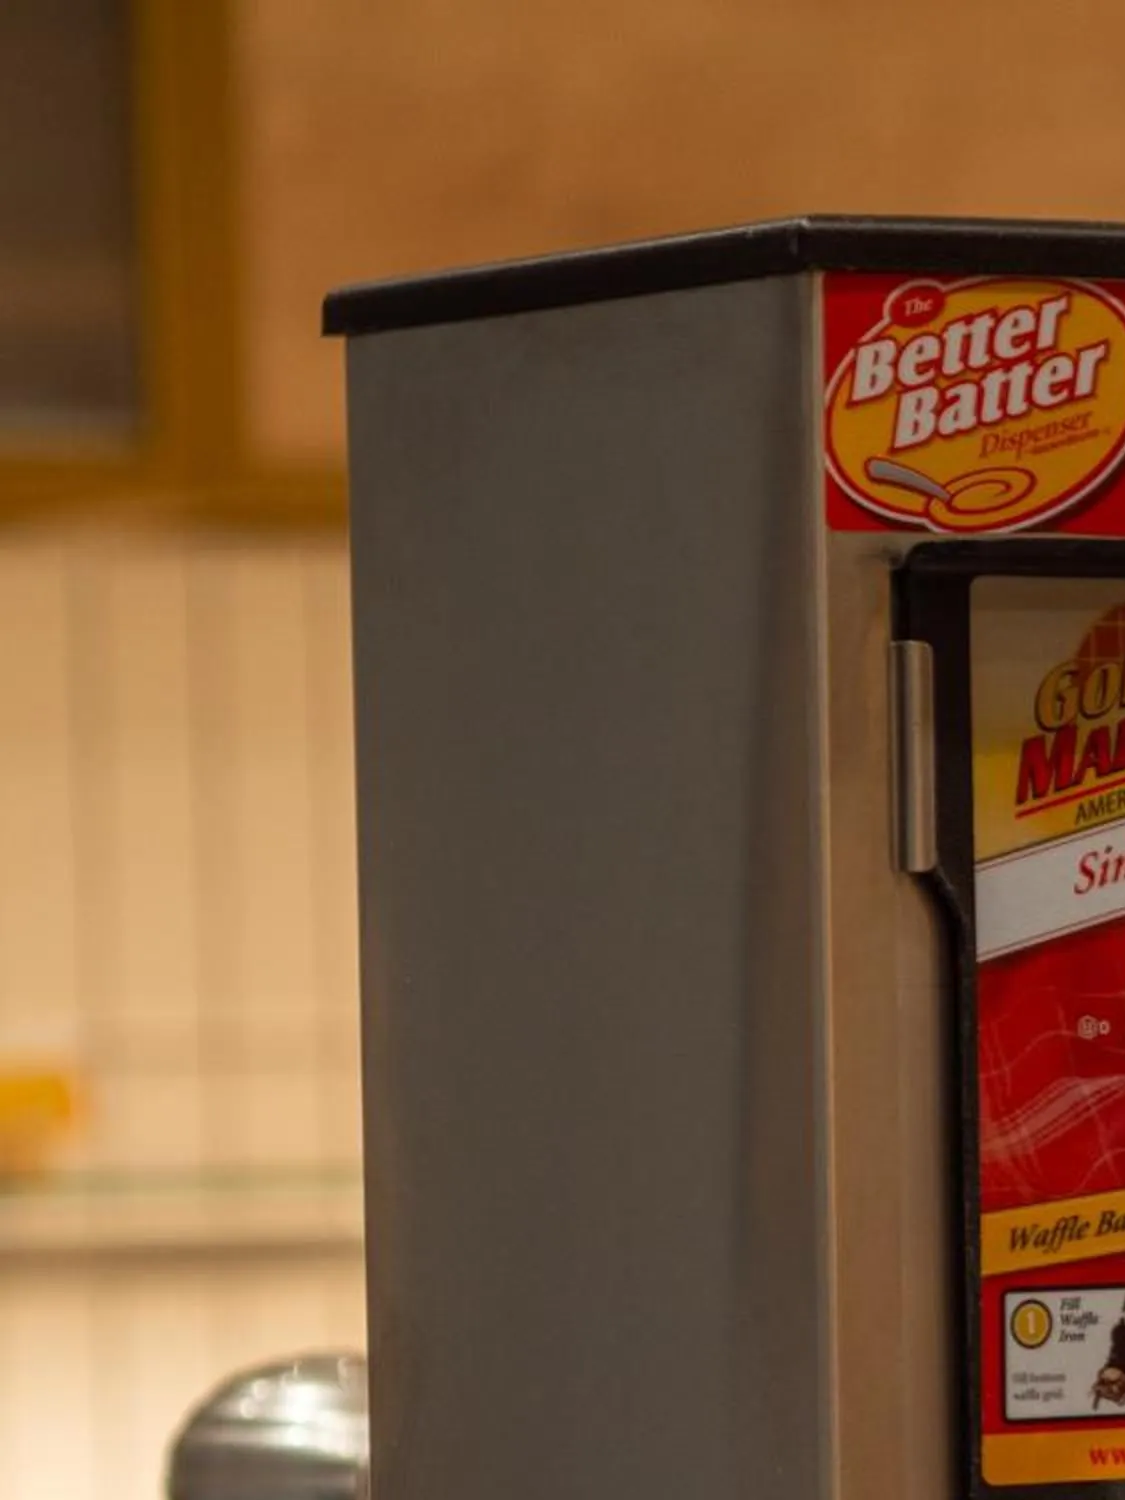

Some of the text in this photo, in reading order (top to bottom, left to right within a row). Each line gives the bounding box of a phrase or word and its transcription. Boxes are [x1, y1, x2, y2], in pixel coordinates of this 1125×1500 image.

[903, 296, 934, 317] The
[850, 293, 1072, 405] Better
[892, 342, 1108, 451] Batter
[979, 411, 1094, 461] Dispenser
[1007, 1216, 1088, 1256] Waffle
[1026, 1311, 1037, 1335] 1
